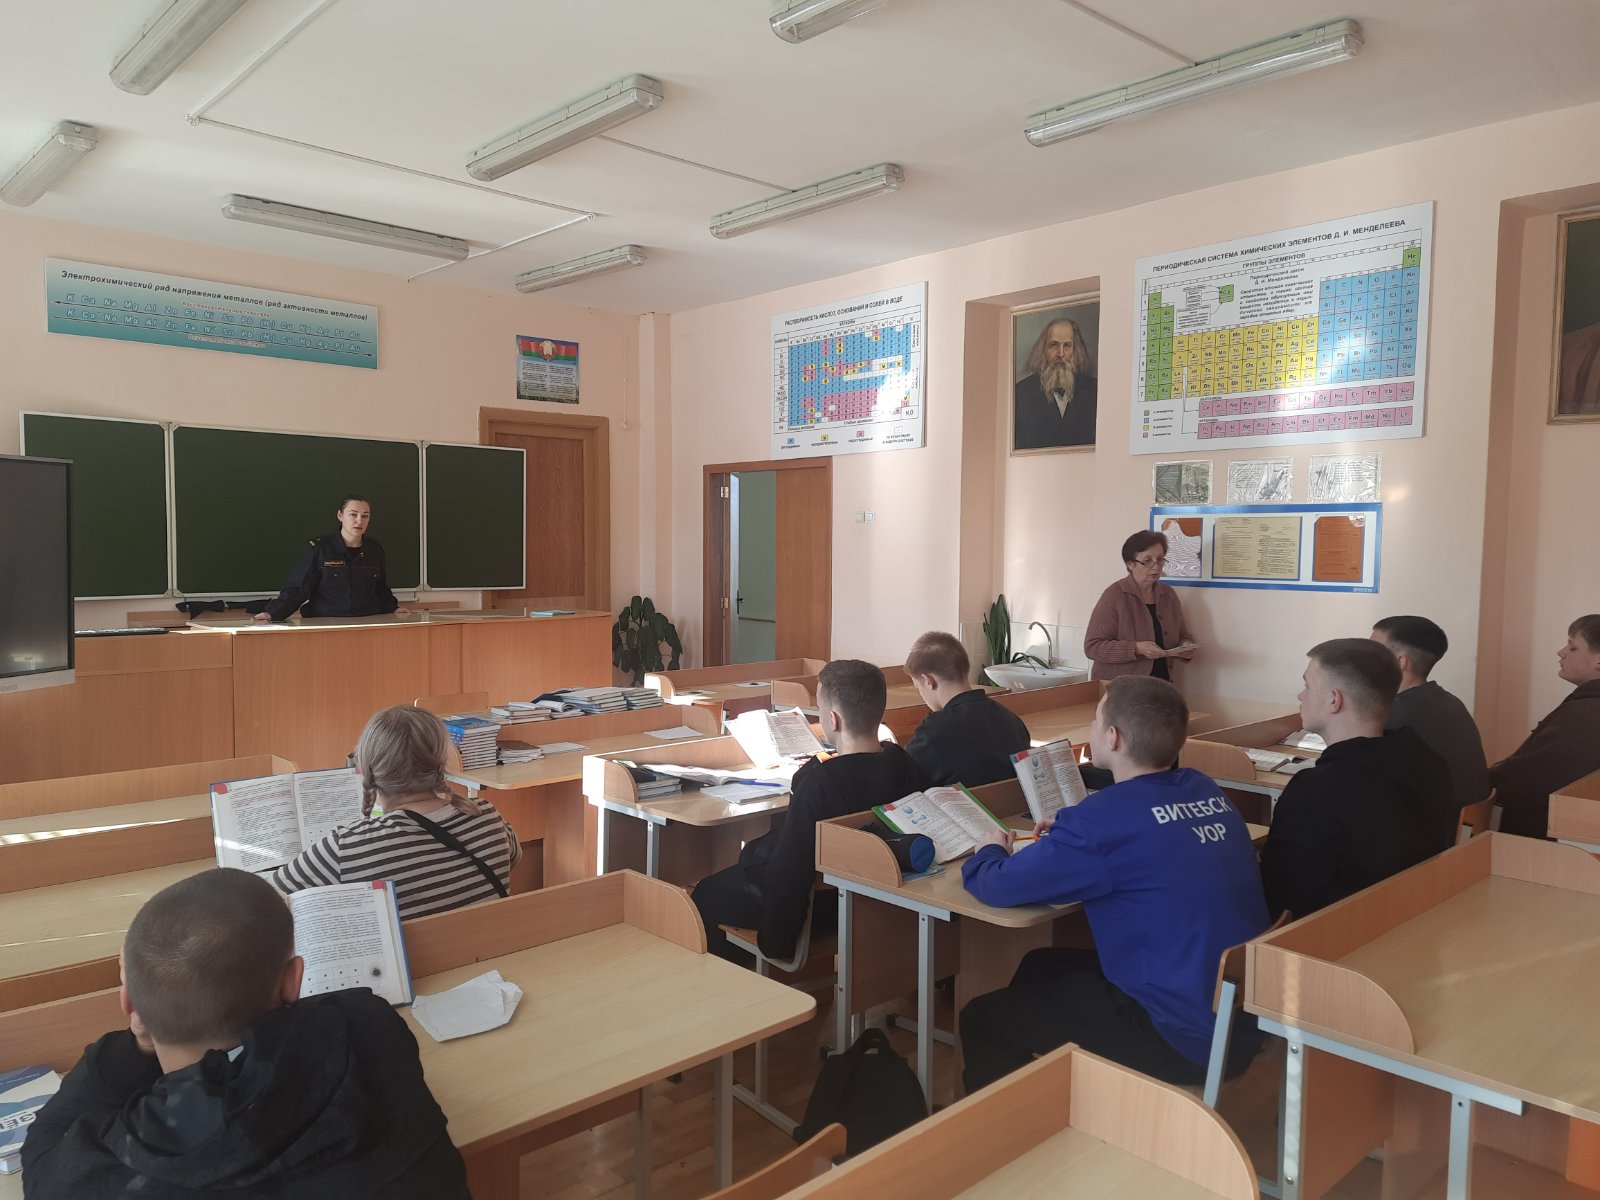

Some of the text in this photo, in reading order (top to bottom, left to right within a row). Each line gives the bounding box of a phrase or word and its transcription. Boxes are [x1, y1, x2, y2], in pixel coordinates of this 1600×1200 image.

[1153, 258, 1206, 272] ПЕРИОДИЧЕСКАЯ
[1208, 252, 1238, 261] СИСТЕМА
[1240, 241, 1286, 255] ХИМИЧЕСКИХ
[1288, 234, 1332, 246] ЭЛЕМЕНТОВ
[1353, 220, 1405, 234] МЕНДЕЛЕЕВА
[1243, 253, 1305, 268] ГРУППЫ ЭЛЕМЕНТОВ
[61, 271, 152, 289] Электрохимический
[172, 287, 221, 299] напряжения
[224, 295, 262, 305] металлов
[283, 304, 328, 314] активности
[331, 310, 367, 321] металлов)
[785, 315, 818, 326] РАСТВОРИМОСТЬ
[890, 296, 903, 304] ВОДЕ
[82, 295, 95, 304] Ca
[104, 298, 116, 307] Na
[124, 301, 138, 310] Mg
[165, 306, 177, 314] Zn
[318, 328, 328, 336] Ag
[1151, 797, 1232, 824] ВИТЕБСК
[1192, 823, 1226, 843] УОР
